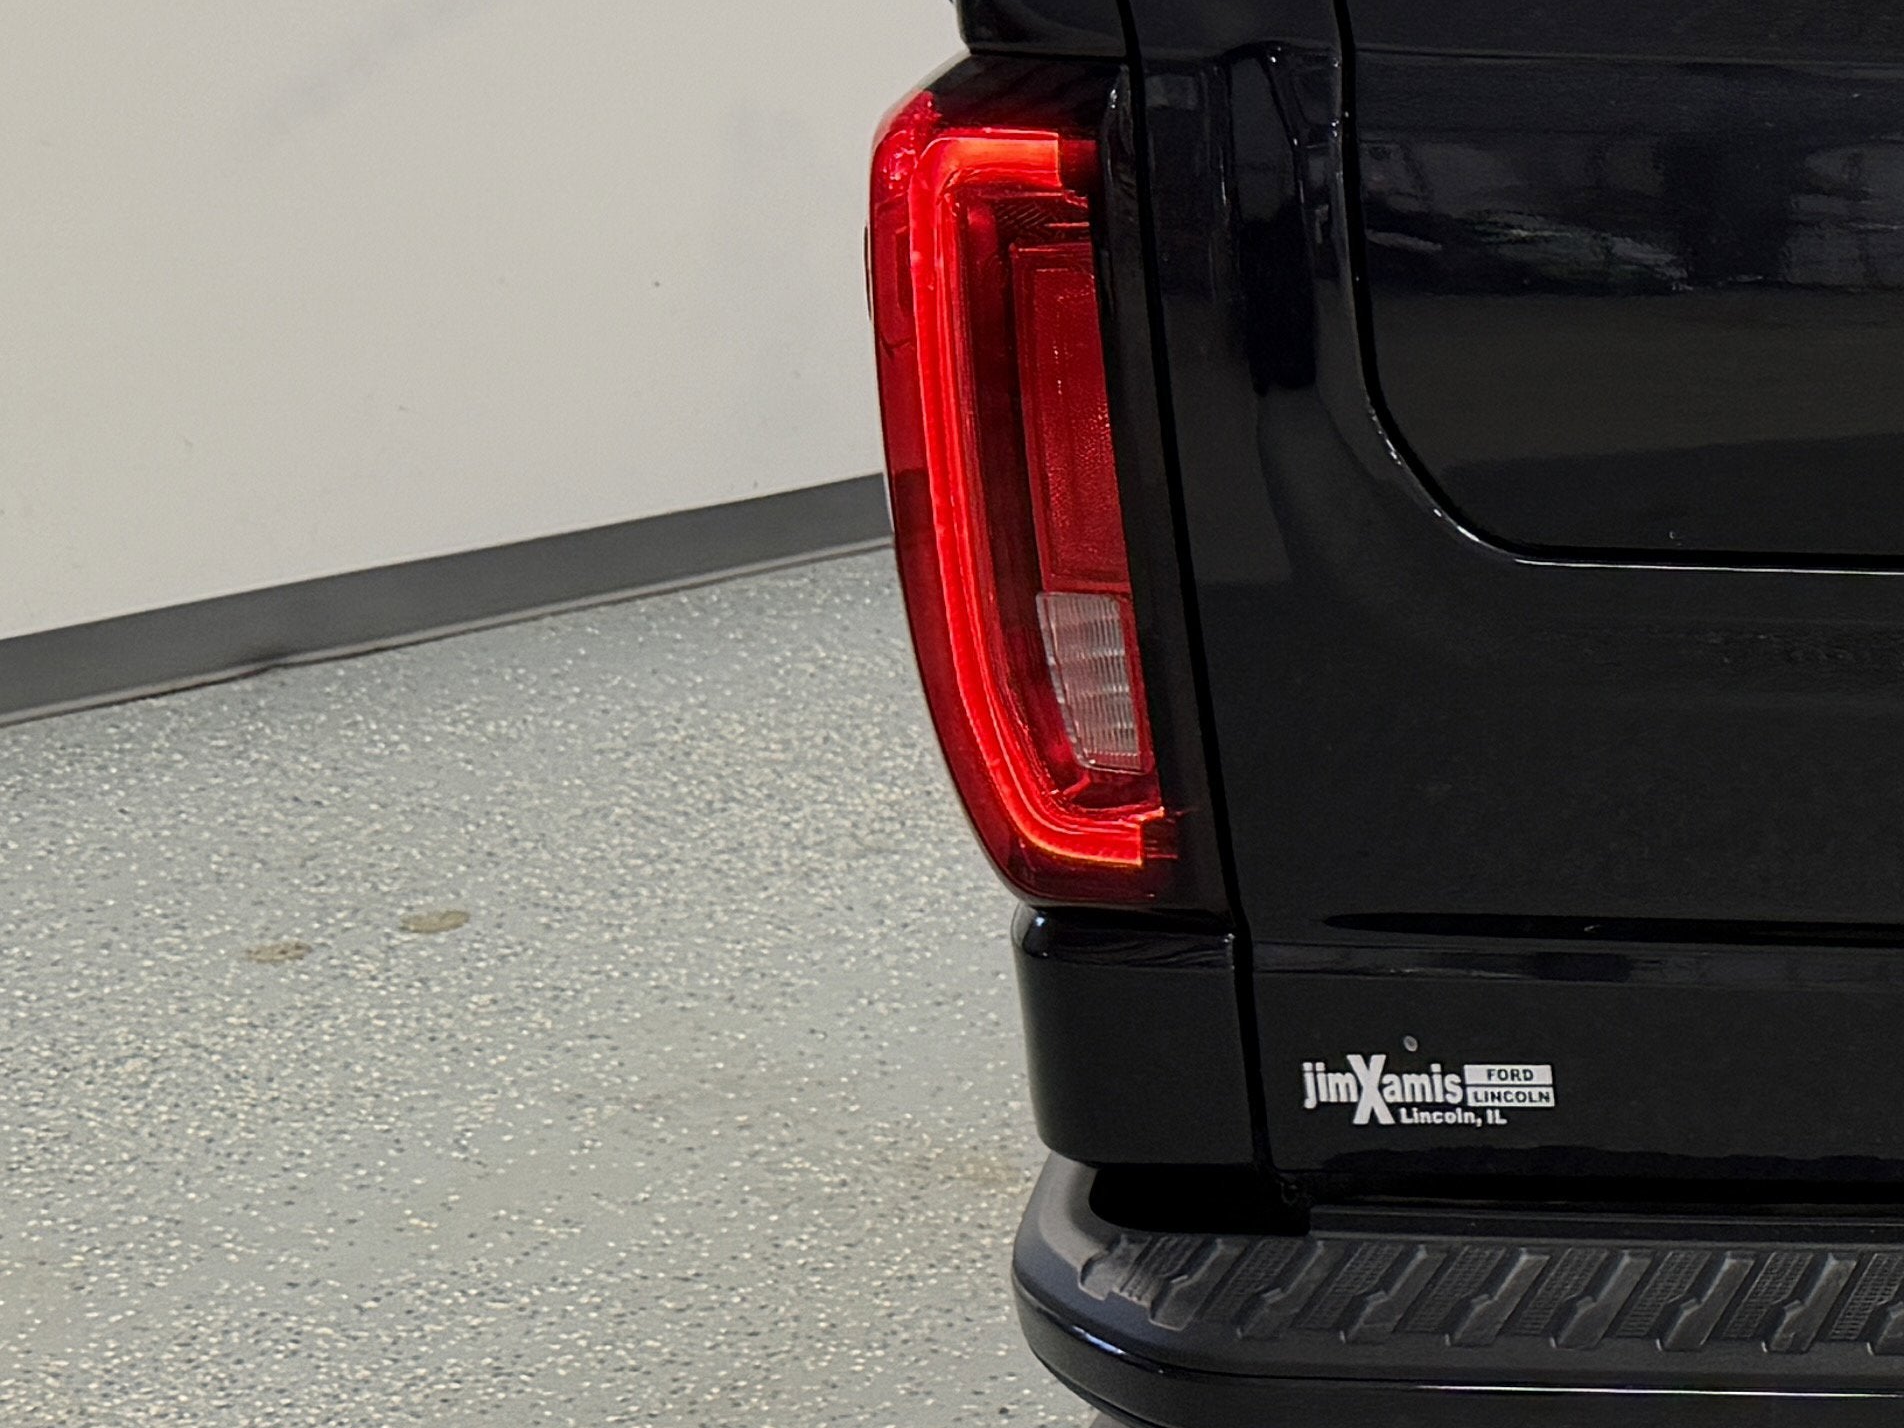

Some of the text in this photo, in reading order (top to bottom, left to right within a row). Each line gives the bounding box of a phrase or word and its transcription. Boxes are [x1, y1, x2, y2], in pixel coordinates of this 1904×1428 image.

[1486, 1067, 1535, 1083] FORD
[1472, 1089, 1551, 1104] LINCOLN
[1400, 1107, 1508, 1128] Lincoln, IL
